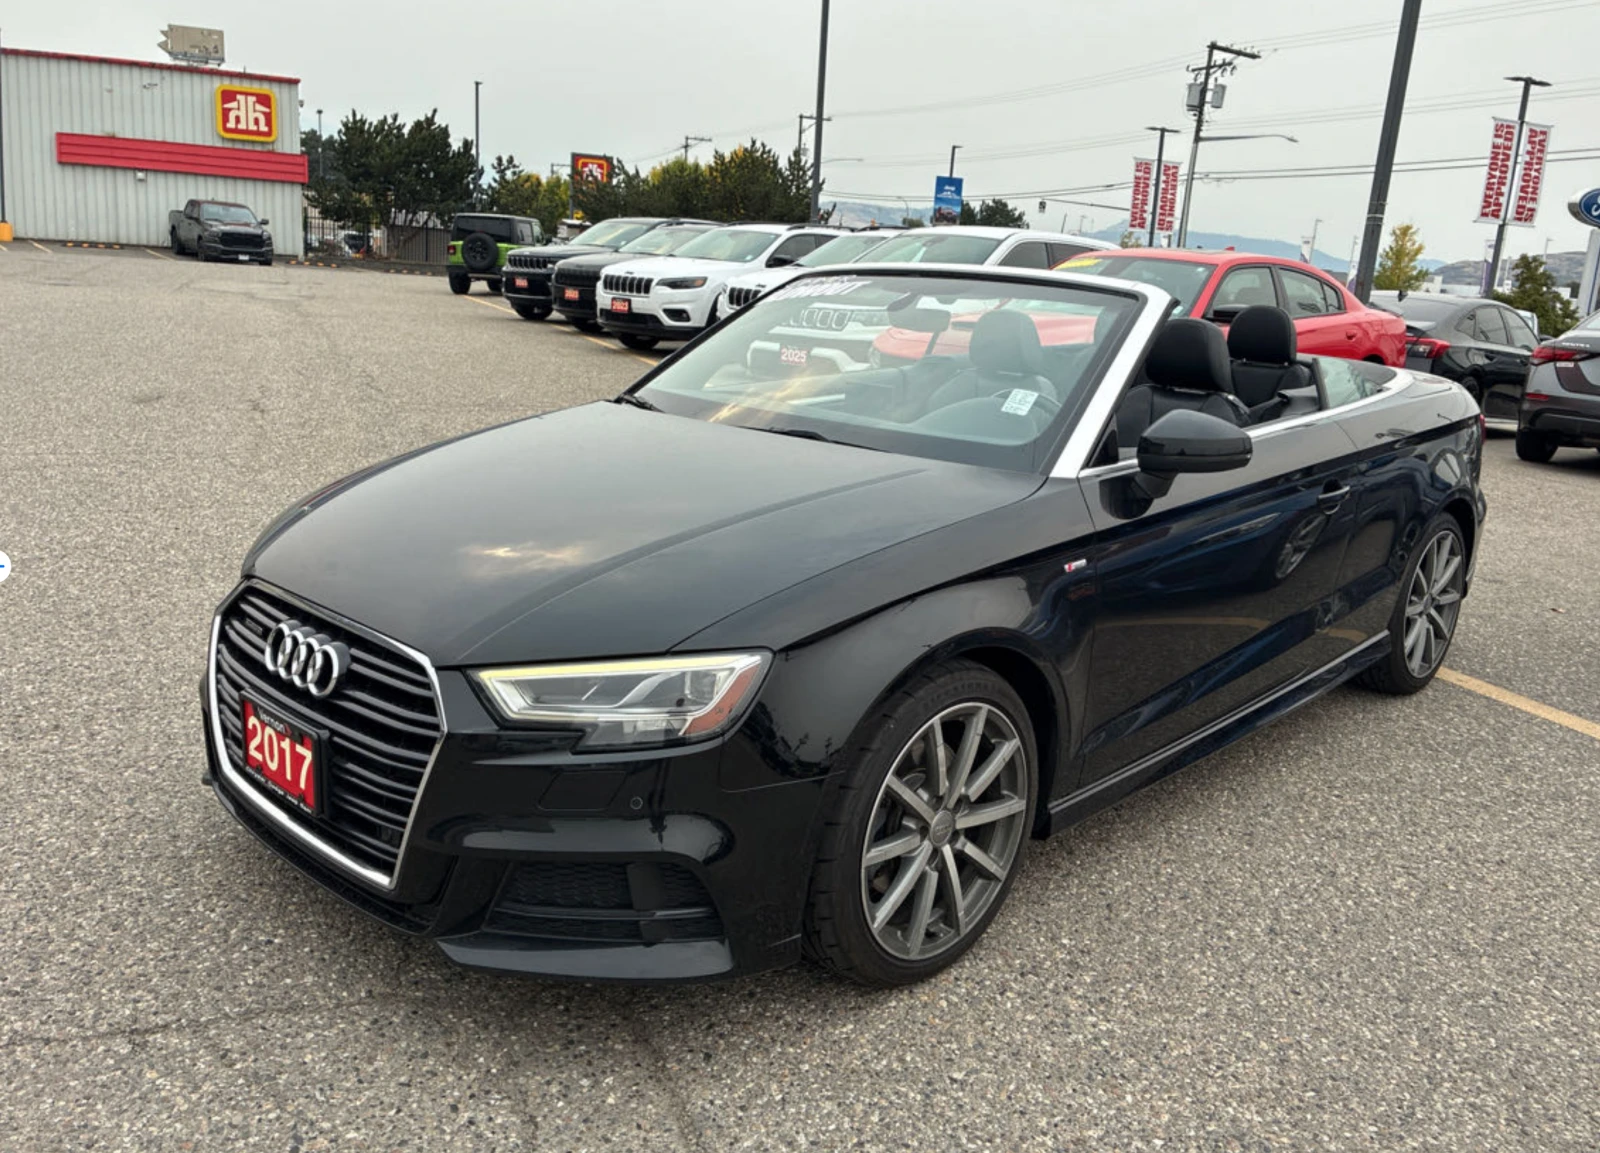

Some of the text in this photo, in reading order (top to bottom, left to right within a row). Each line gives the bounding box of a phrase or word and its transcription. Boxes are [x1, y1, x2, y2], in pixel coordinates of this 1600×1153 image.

[1129, 175, 1143, 229] EVERYONE
[1167, 165, 1179, 218] EVERYONE
[1480, 122, 1505, 218] EVERYONE IS
[1490, 124, 1516, 219] APPROVED!
[1514, 127, 1538, 222] APPROVED!
[1523, 130, 1548, 223] EVERYONE IS
[781, 347, 807, 362] 2025
[247, 715, 313, 791] 2017
